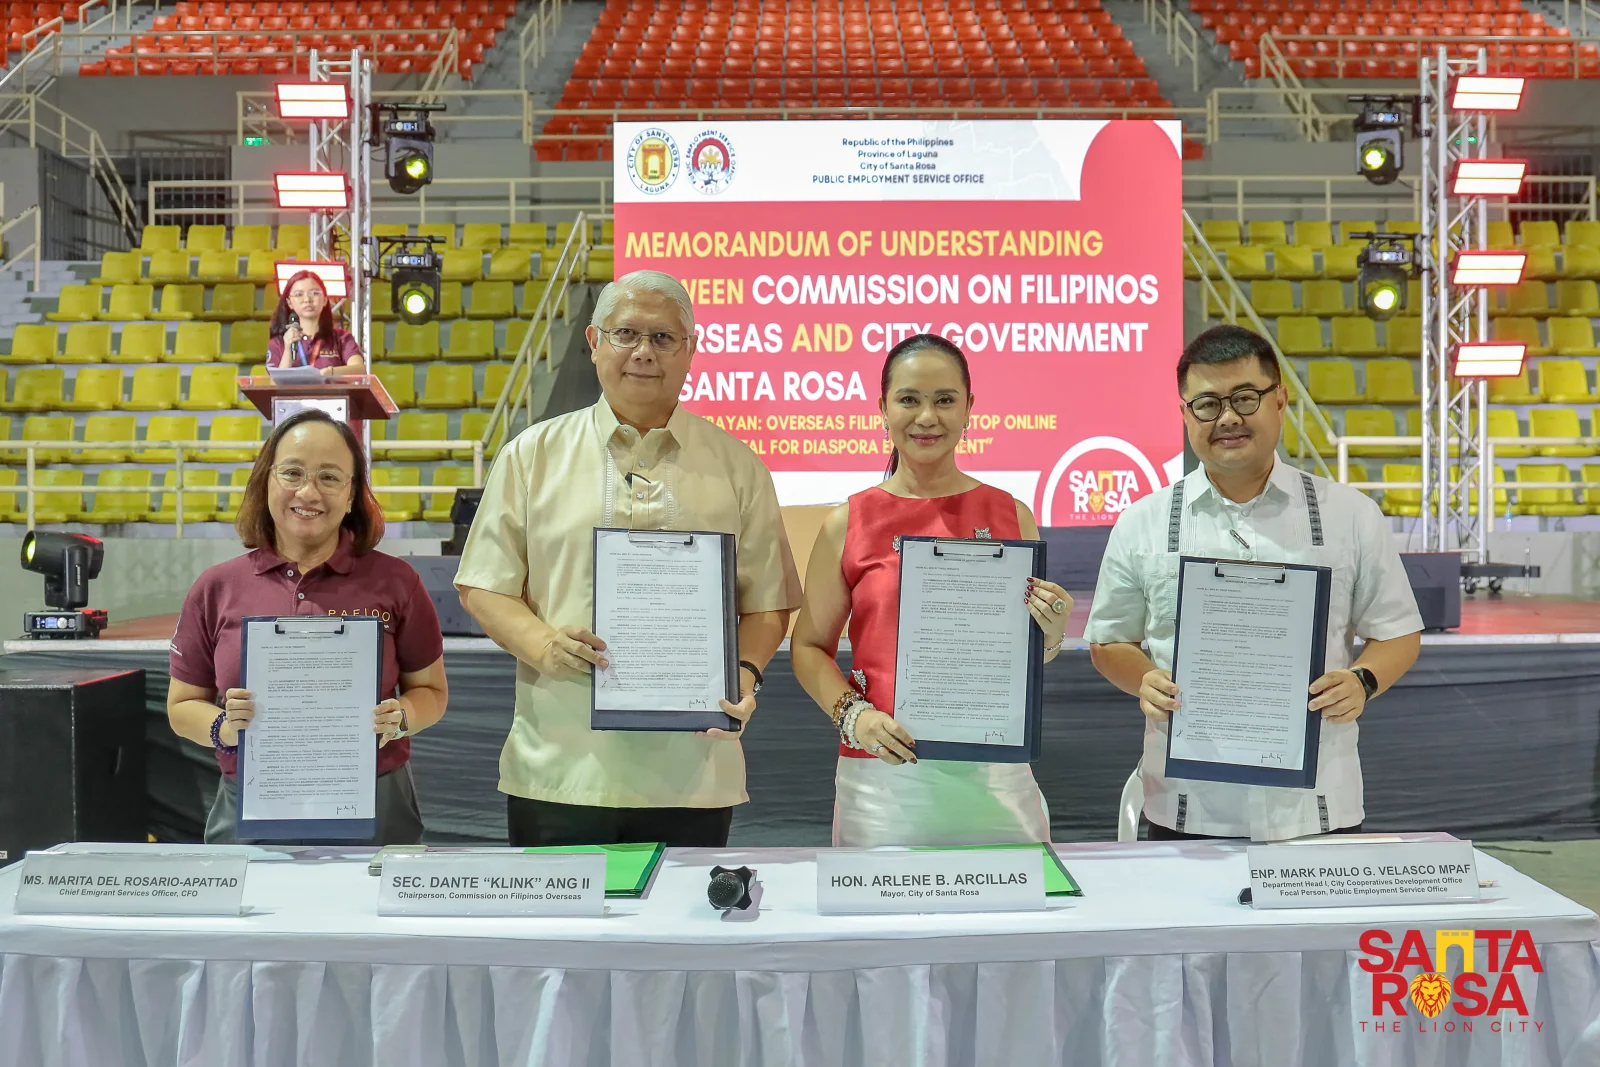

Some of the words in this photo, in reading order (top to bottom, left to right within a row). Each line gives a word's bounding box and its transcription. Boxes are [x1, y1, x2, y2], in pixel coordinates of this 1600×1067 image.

[646, 130, 670, 143] SANTA
[842, 138, 879, 147] Republic
[881, 138, 891, 146] of
[891, 138, 906, 146] the
[907, 138, 954, 147] Philippines
[858, 150, 895, 158] Province
[897, 150, 906, 158] of
[907, 150, 938, 159] Laguna
[860, 162, 878, 171] City
[890, 162, 914, 170] Santa
[916, 162, 936, 170] Rosa
[812, 174, 845, 183] PUBLIC
[848, 174, 910, 183] EMPLOYMENT
[912, 174, 951, 183] SERVICE
[953, 174, 984, 183] OFFICE
[640, 182, 670, 192] LAGUNA
[624, 230, 830, 258] MEMORANDUM
[837, 230, 872, 257] OF
[881, 230, 1103, 257] UNDERSTANDING
[681, 278, 744, 304] EEN
[752, 274, 958, 304] COMMISSION
[967, 274, 1011, 304] ON
[1021, 274, 1158, 304] FILIPINOS
[790, 323, 853, 352] AND
[941, 322, 1148, 352] GOVERNMENT
[678, 370, 776, 402] SANTA
[784, 370, 867, 401] ROSA
[702, 415, 762, 430] AYAN:
[766, 415, 845, 431] OVERSEAS
[849, 415, 886, 430] FILIP
[1004, 414, 1057, 430] ONLINE
[740, 439, 767, 455] AL
[770, 439, 800, 455] FOR
[803, 439, 878, 455] DIASPORA
[1068, 470, 1140, 492] SANTA
[1251, 869, 1277, 879] ENP.
[1280, 868, 1316, 878] MARK
[1319, 867, 1360, 878] PAULO
[1363, 866, 1375, 876] G.
[1378, 865, 1435, 876] VELASCO
[1439, 864, 1471, 874] MPAF
[24, 876, 44, 885] MS.
[48, 876, 93, 886] MARITA
[97, 876, 120, 886] DEL
[124, 876, 237, 888] ROSARIO-APATTAD
[392, 876, 425, 888] SEC.
[429, 877, 479, 888] DANTE
[484, 877, 542, 889] “KLINK”
[546, 878, 577, 889] ANG
[582, 878, 590, 889] II
[831, 876, 867, 887] HON.
[872, 875, 931, 887] ARLENE
[936, 874, 950, 886] B.
[954, 873, 1027, 885] ARCILLAS
[1262, 881, 1303, 889] Department
[1331, 880, 1344, 888] City
[1347, 879, 1393, 887] Cooperatives
[1394, 878, 1440, 886] Development
[81, 889, 116, 898] Emigrant
[151, 889, 179, 898] Officer,
[398, 892, 446, 900] Chairperson,
[510, 892, 543, 901] Filipinos
[880, 890, 906, 898] Mayor,
[908, 890, 924, 898] City
[1354, 887, 1398, 896] Employment
